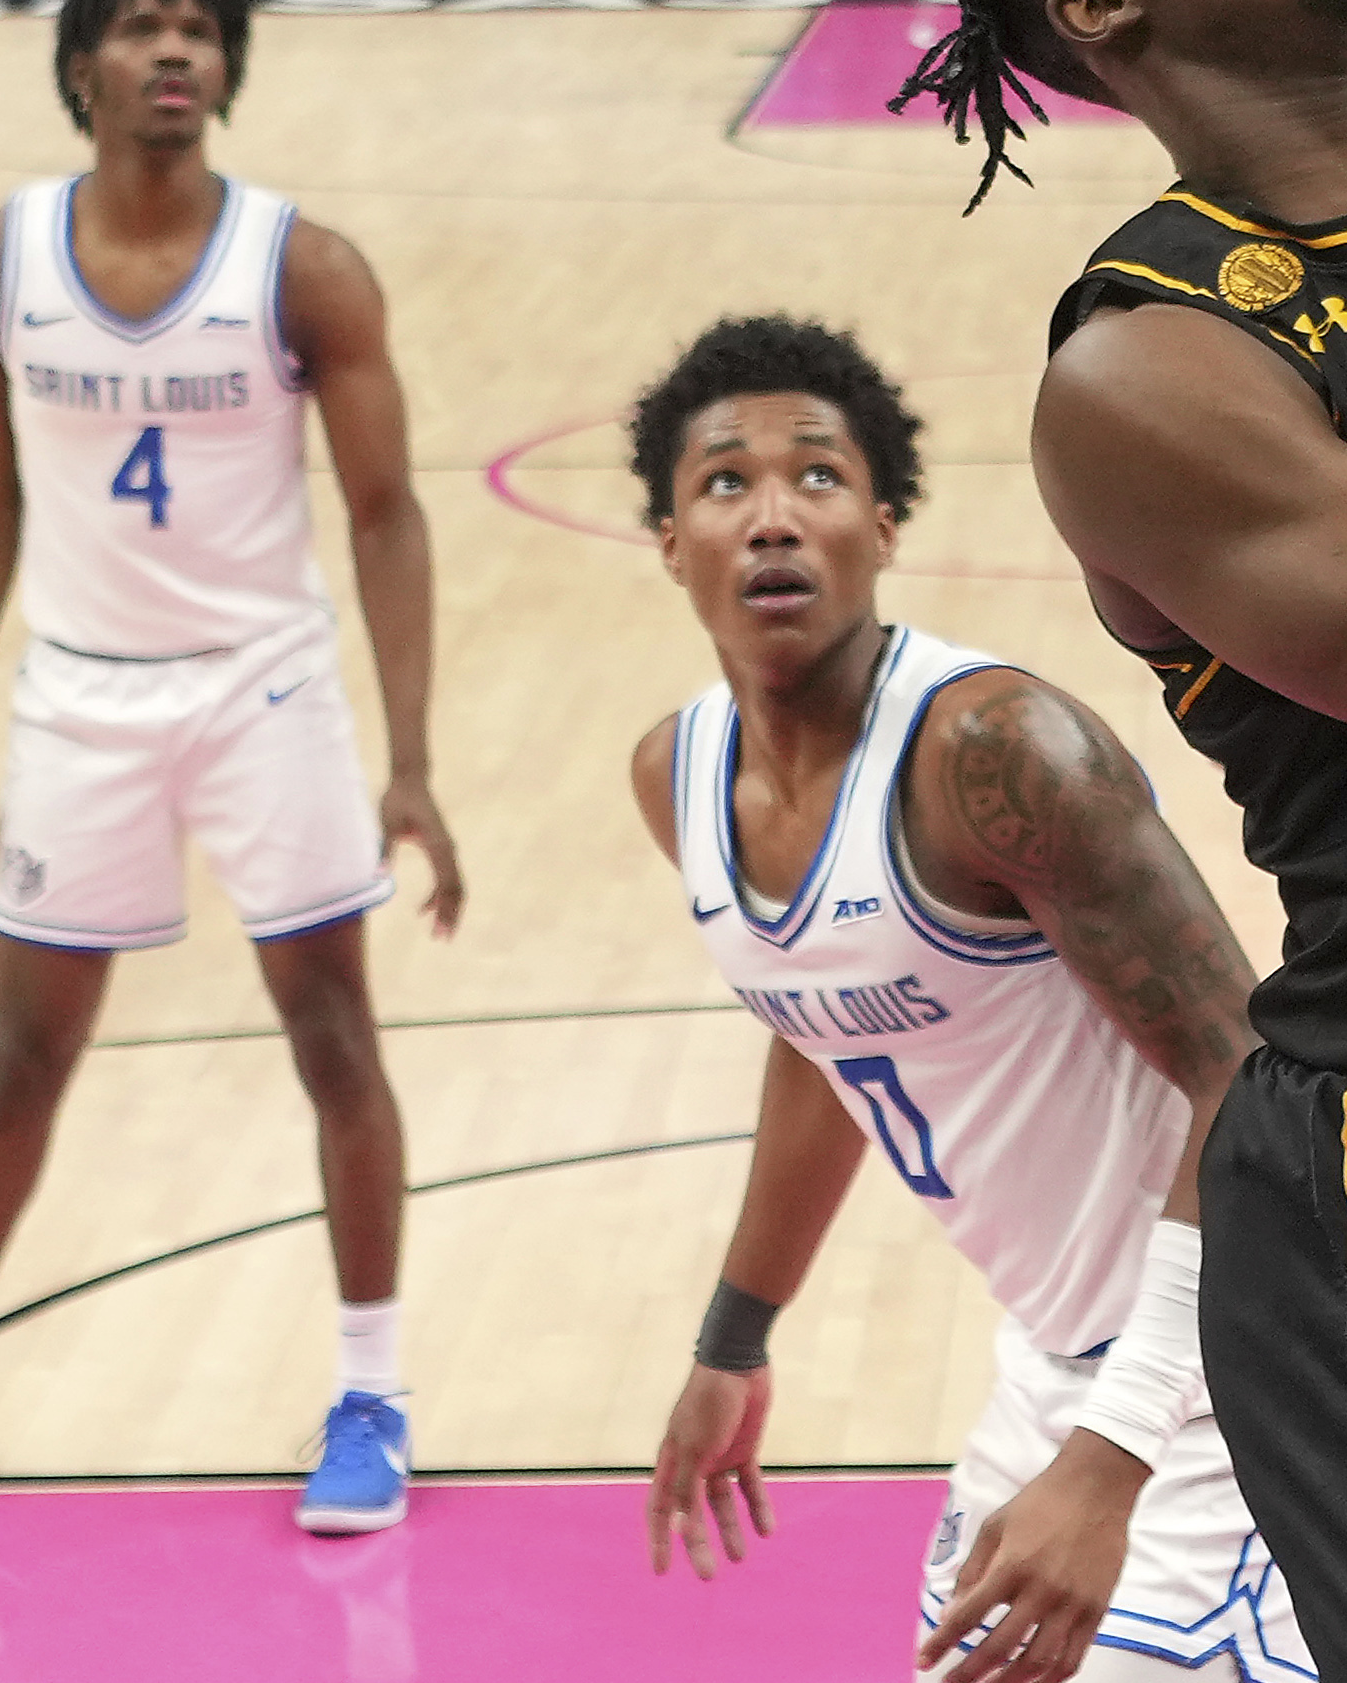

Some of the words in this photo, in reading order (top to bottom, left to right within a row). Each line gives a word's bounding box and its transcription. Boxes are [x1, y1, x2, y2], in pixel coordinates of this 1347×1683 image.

[24, 362, 124, 412] SAINT
[141, 369, 251, 413] LOUIS
[110, 425, 173, 529] 4
[815, 973, 952, 1038] LOUIS
[832, 1055, 956, 1200] 0
